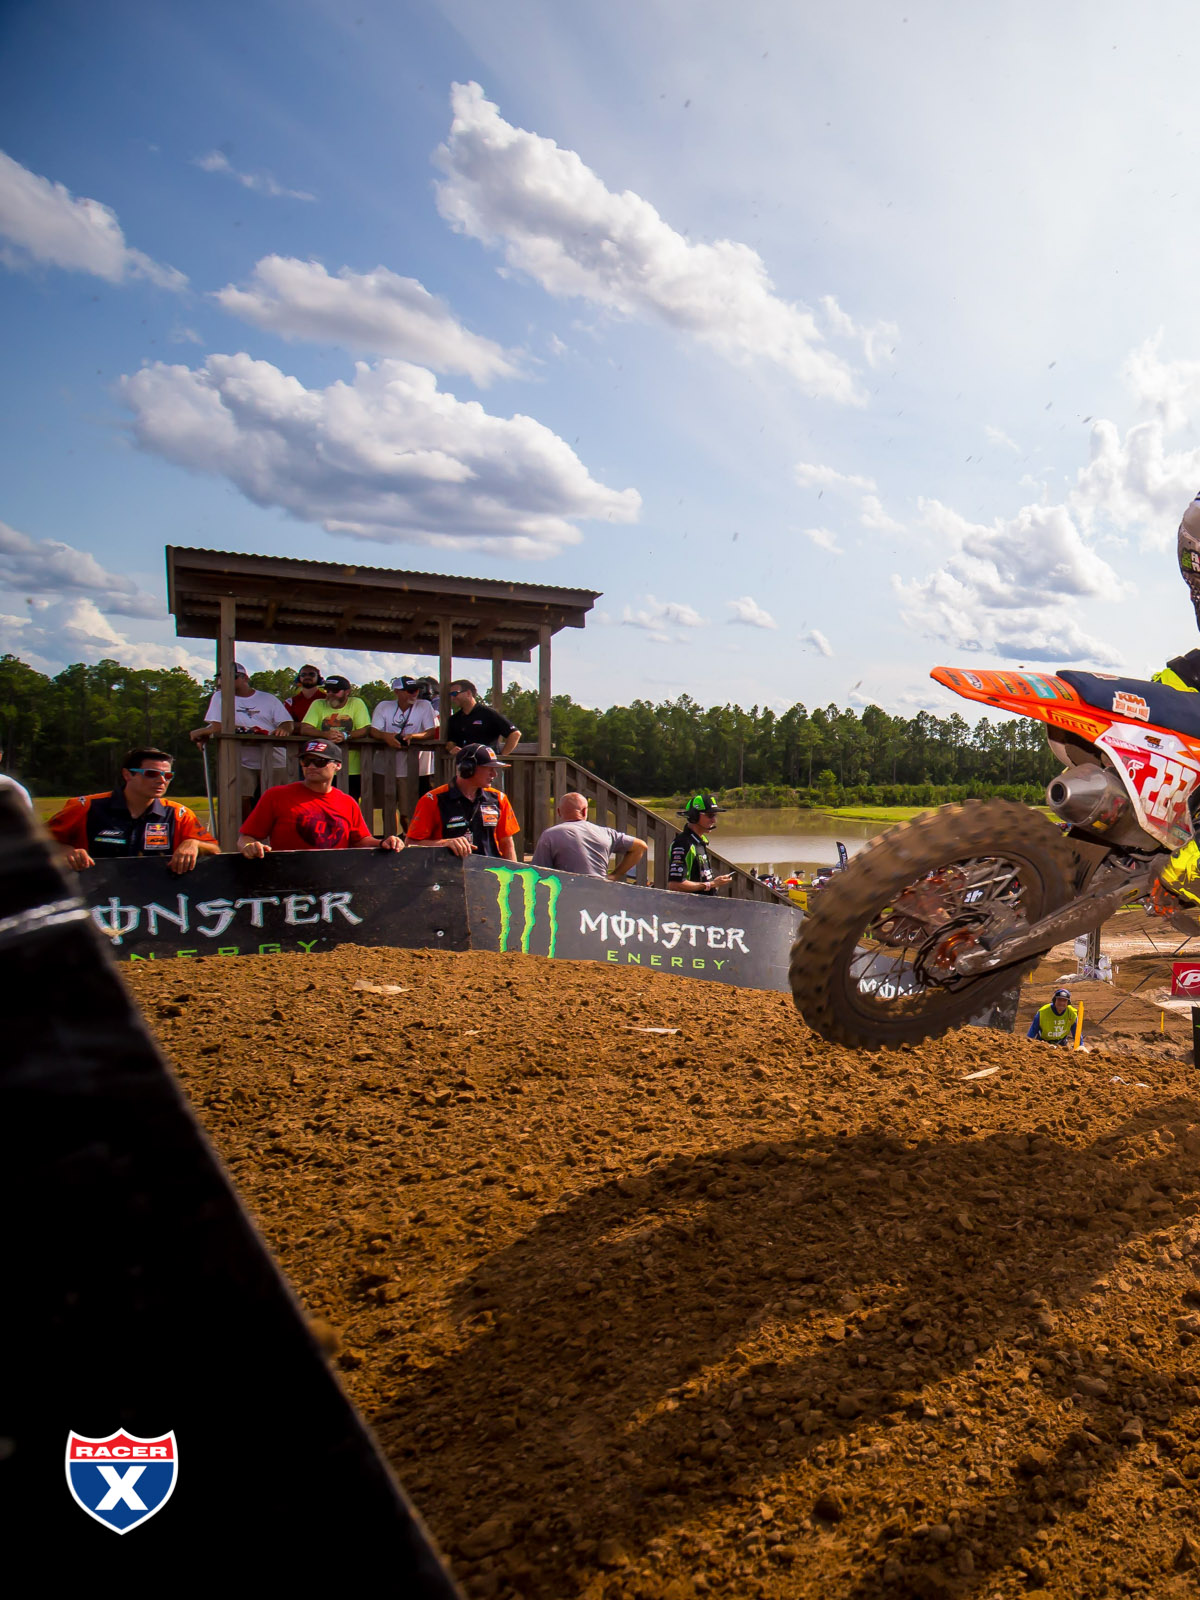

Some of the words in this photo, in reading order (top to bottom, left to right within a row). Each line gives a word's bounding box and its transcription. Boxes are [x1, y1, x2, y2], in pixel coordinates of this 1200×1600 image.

[1139, 752, 1197, 823] 222
[91, 893, 363, 945] ONSTER
[579, 908, 750, 953] MONSTER
[607, 951, 726, 970] ENERGY
